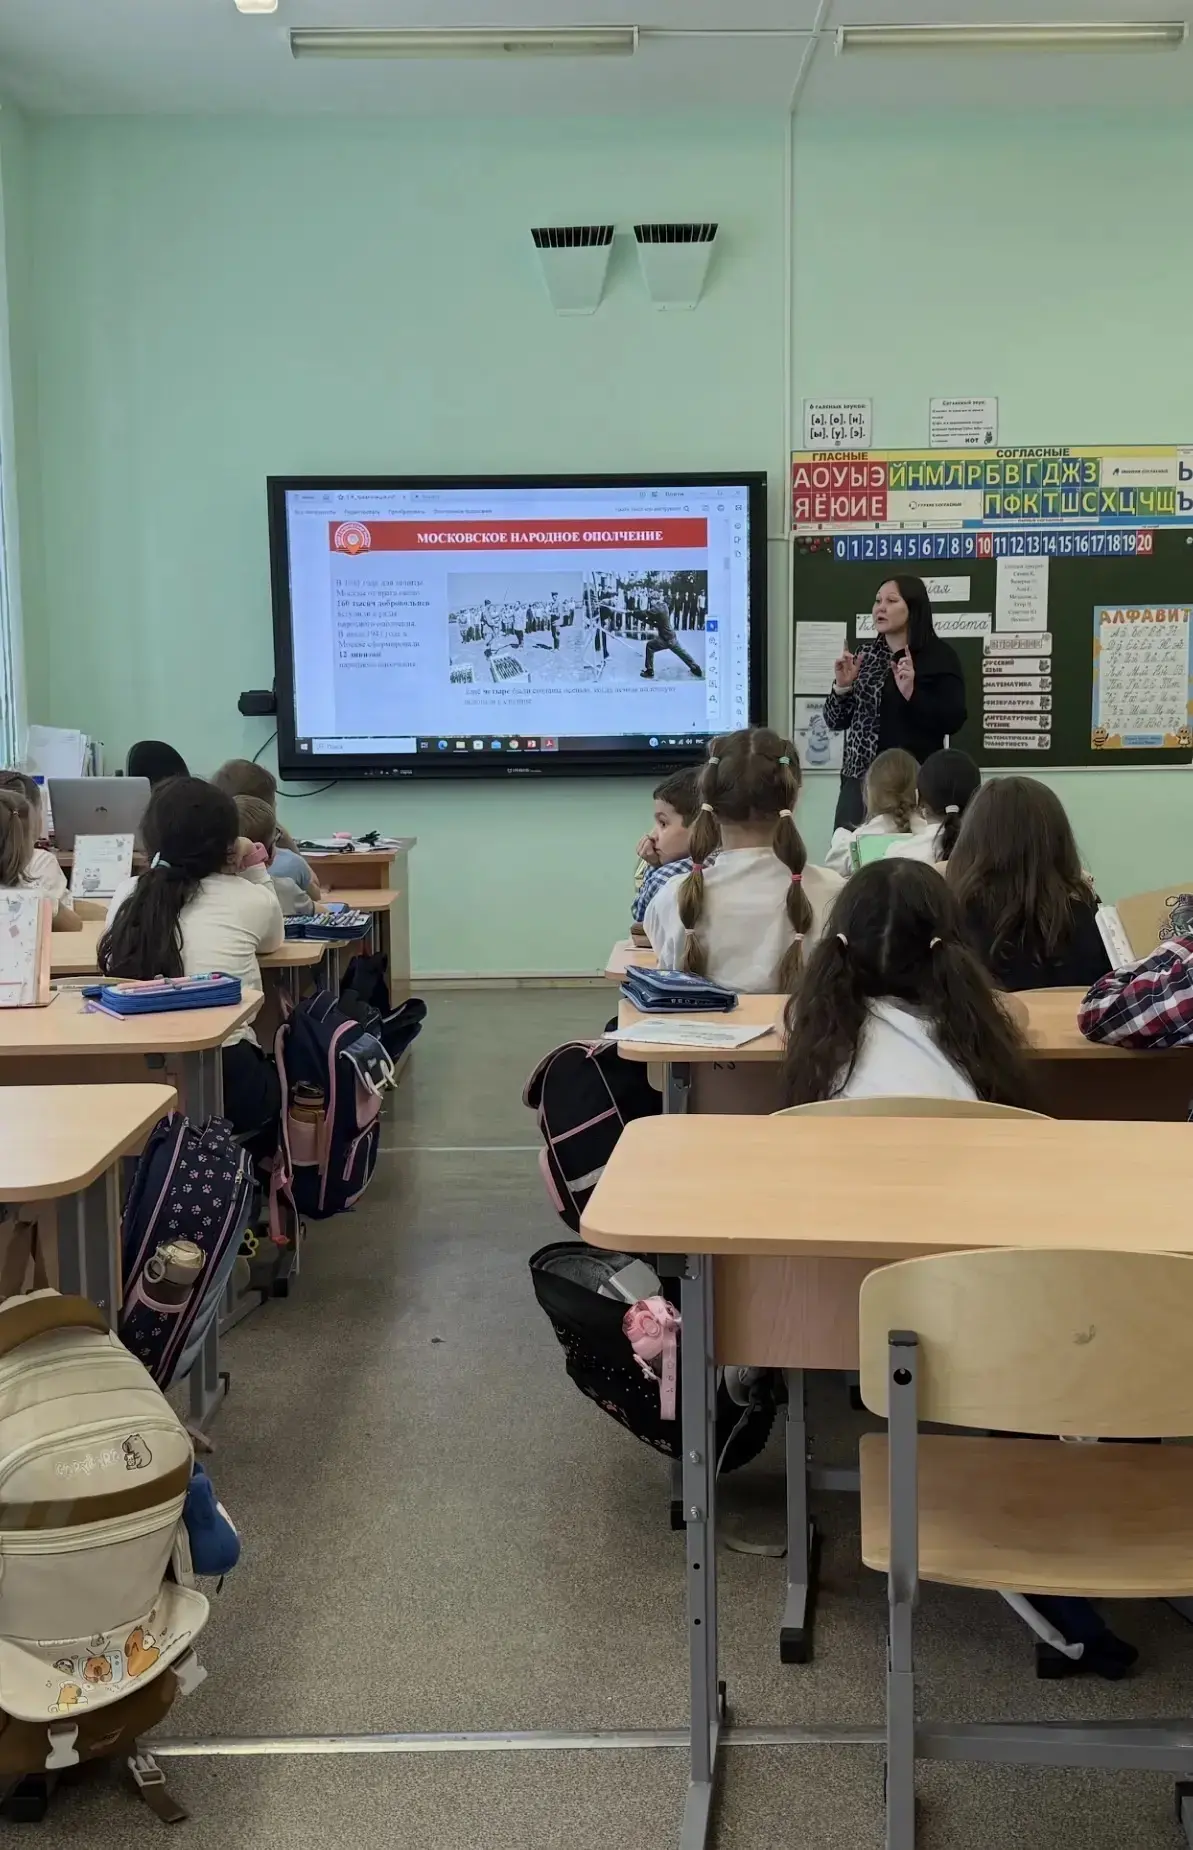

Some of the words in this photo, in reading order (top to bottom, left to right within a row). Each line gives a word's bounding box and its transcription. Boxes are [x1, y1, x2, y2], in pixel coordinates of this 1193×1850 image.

[812, 452, 869, 461] ГЛАСНЫЕ
[996, 448, 1070, 458] СОГЛАСНЫЕ
[416, 532, 508, 544] МОСКОВСКОЕ
[510, 532, 580, 544] НАРОДНОЕ
[582, 530, 664, 542] ОПОЛЧЕНИЕ
[836, 541, 846, 558] 0
[852, 540, 858, 557] 1
[865, 540, 874, 557] 2
[880, 540, 887, 556] 3
[893, 539, 902, 556] 4
[908, 539, 916, 556] 5
[922, 538, 931, 555] 6
[937, 538, 945, 555] 7
[951, 538, 960, 554] 8
[965, 537, 974, 554] 9
[978, 537, 991, 554] 10
[994, 536, 1007, 554] 11
[1010, 536, 1024, 554] 12
[1027, 536, 1040, 553] 13
[1042, 536, 1056, 553] 14
[1058, 536, 1072, 553] 15
[1074, 535, 1088, 553] 16
[1091, 535, 1104, 552] 17
[1106, 535, 1121, 552] 18
[1123, 535, 1136, 552] 19
[1138, 534, 1152, 551] 20
[1100, 608, 1191, 624] АЛФАВИТ
